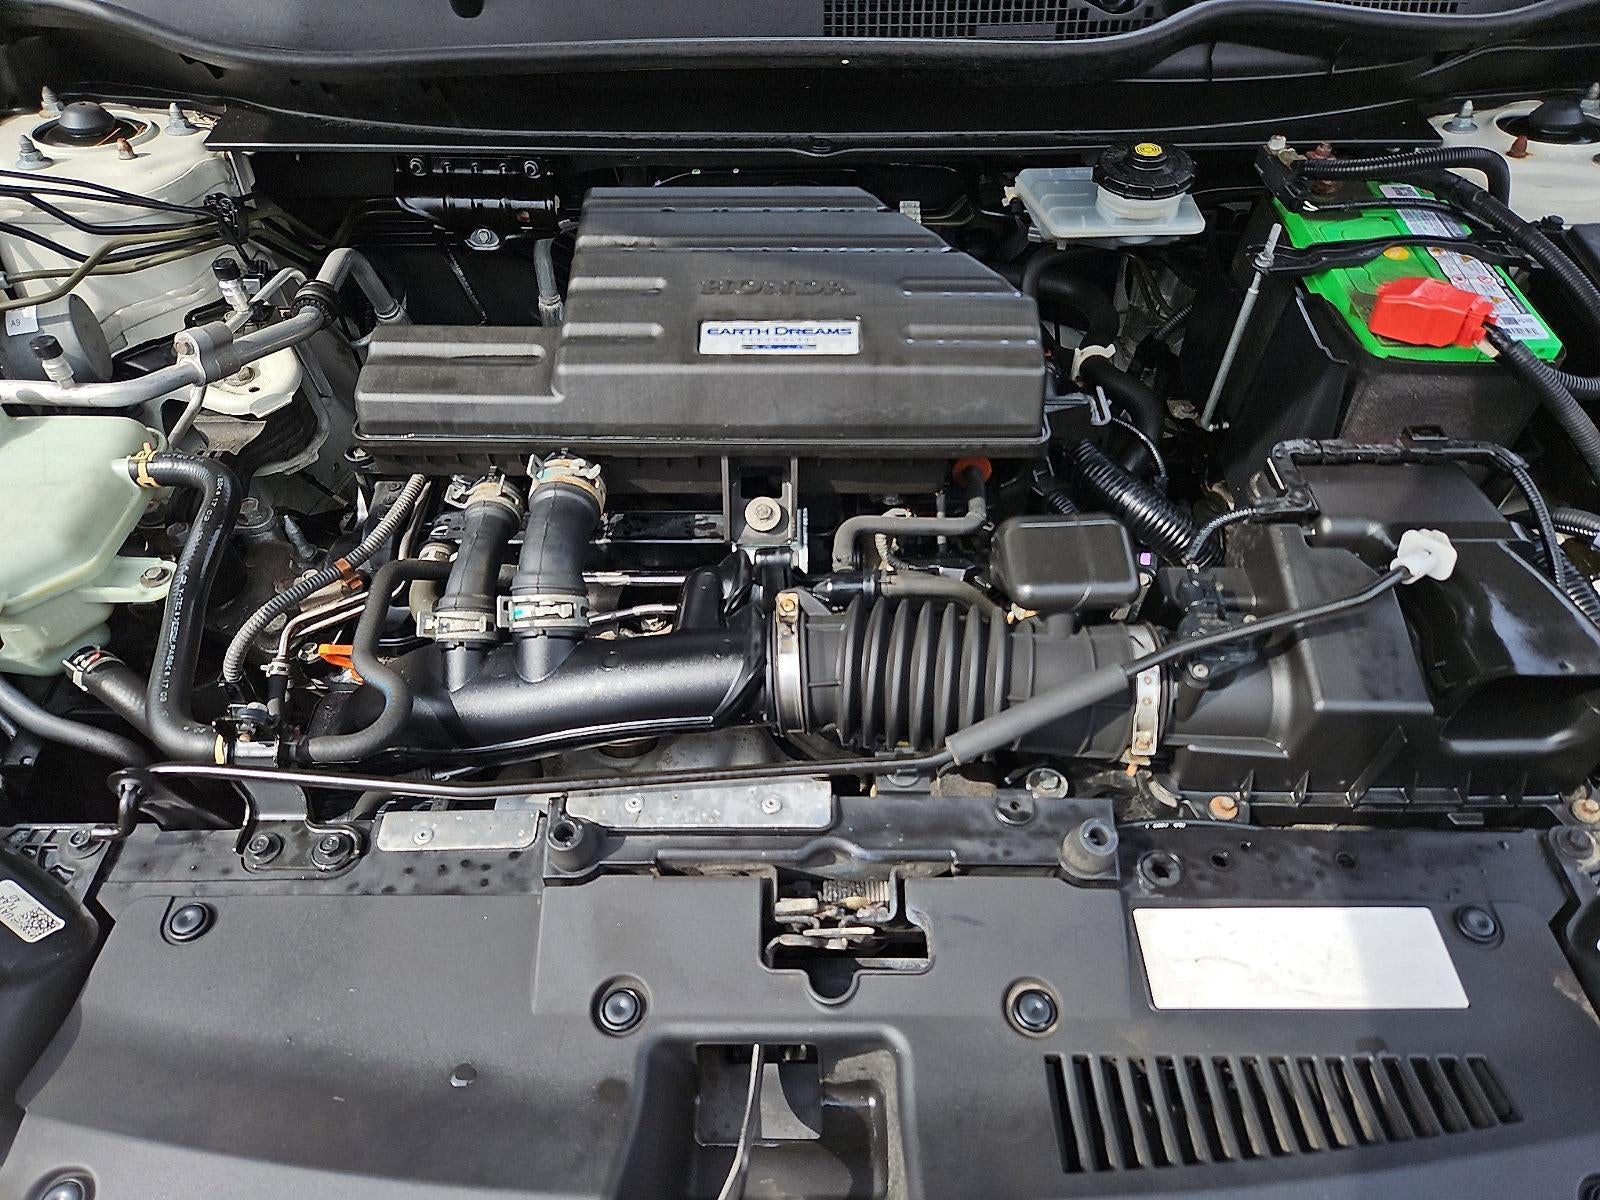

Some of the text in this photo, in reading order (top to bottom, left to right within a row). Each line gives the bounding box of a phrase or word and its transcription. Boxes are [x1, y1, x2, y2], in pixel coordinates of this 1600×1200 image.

[700, 279, 856, 295] HONDA
[707, 326, 851, 335] EARTH DREAMS
